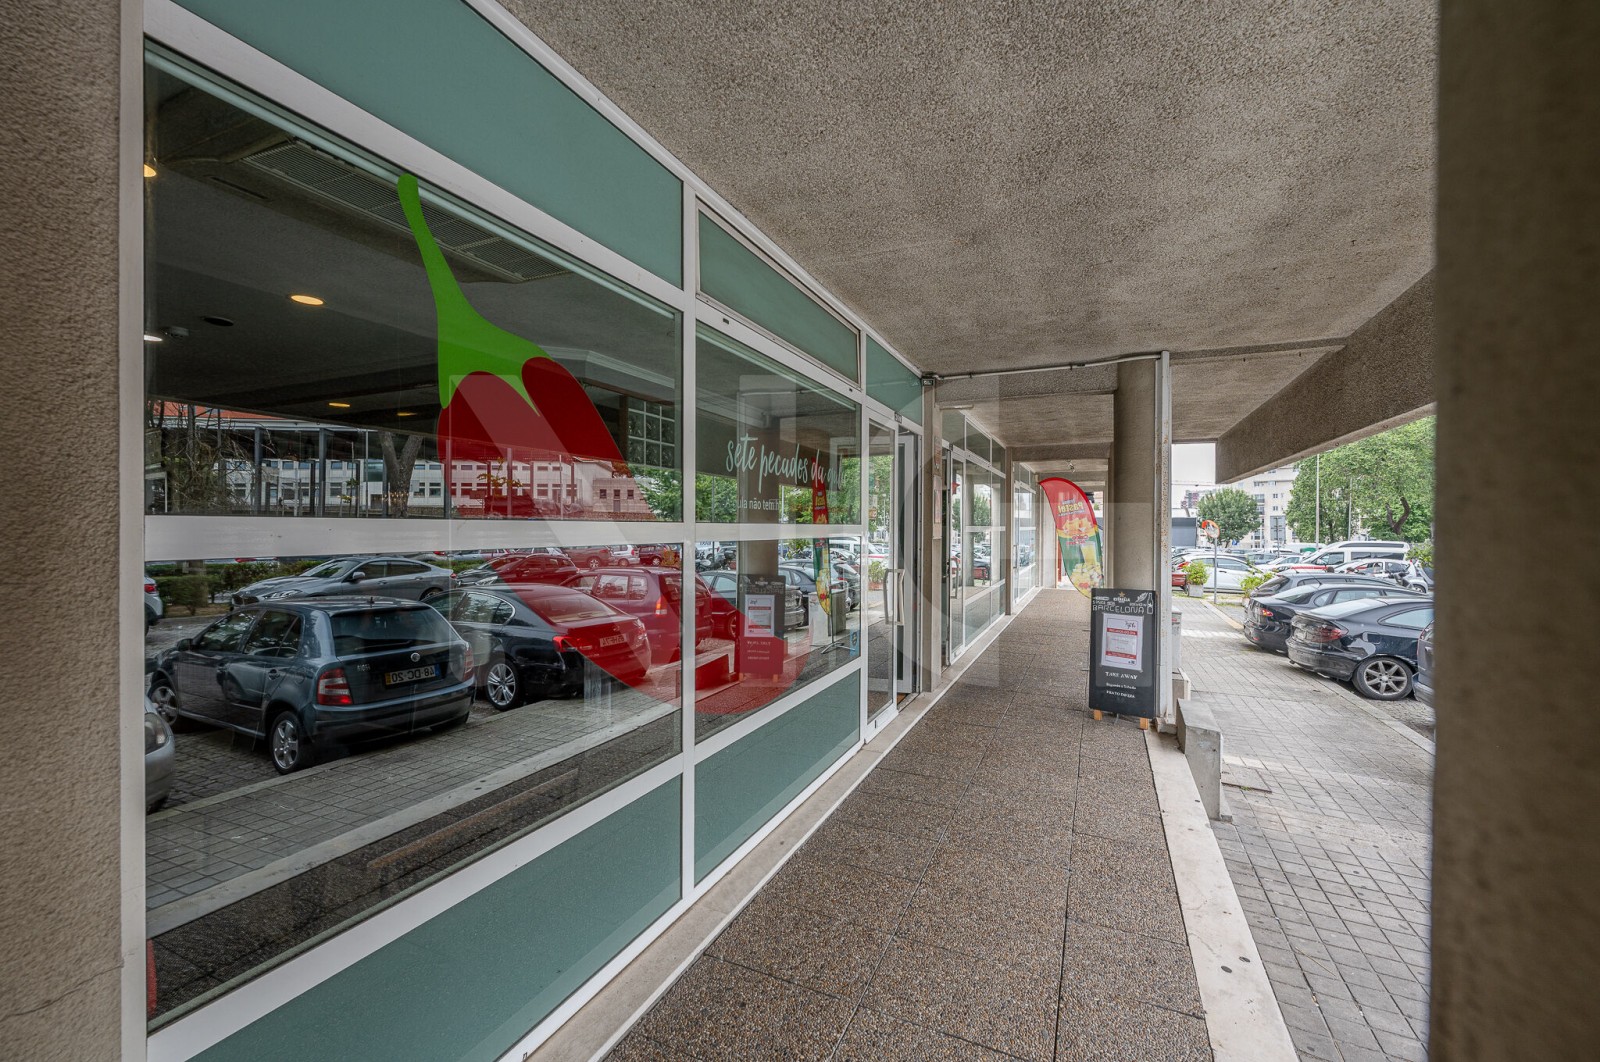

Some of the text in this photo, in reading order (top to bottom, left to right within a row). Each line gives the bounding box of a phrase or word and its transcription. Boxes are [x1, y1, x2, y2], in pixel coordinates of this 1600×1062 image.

[726, 433, 758, 473] sete
[758, 443, 808, 494] pecados
[811, 449, 826, 488] da
[749, 497, 762, 510] não
[1092, 604, 1145, 615] BARCELONA
